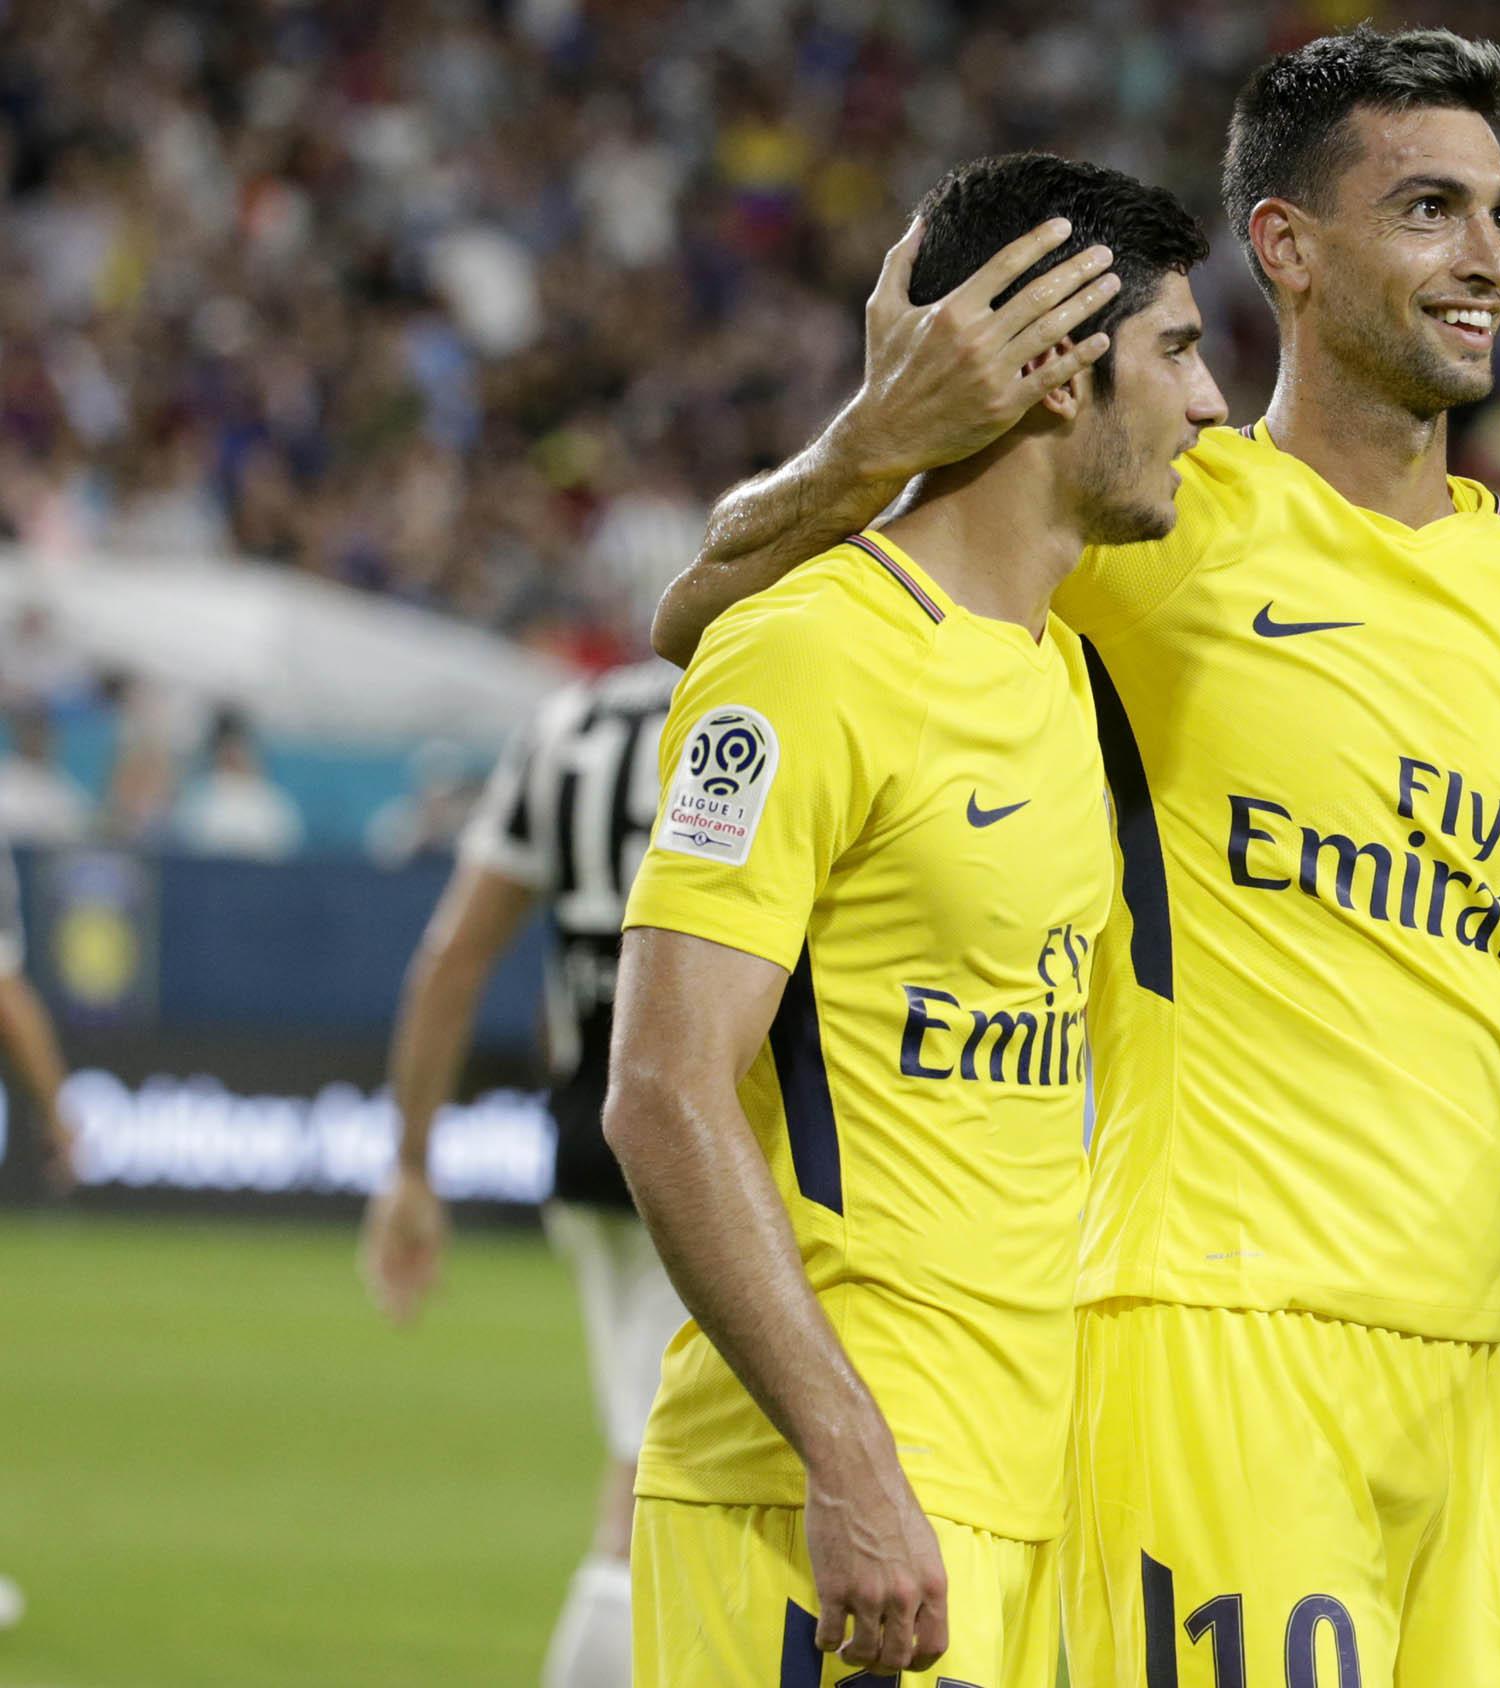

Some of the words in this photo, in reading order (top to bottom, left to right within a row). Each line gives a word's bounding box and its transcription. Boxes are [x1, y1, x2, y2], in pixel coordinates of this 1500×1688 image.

[681, 795, 730, 816] LIGUE
[738, 808, 744, 819] 1
[671, 808, 745, 837] Conforama
[1183, 1593, 1362, 1688] 10
